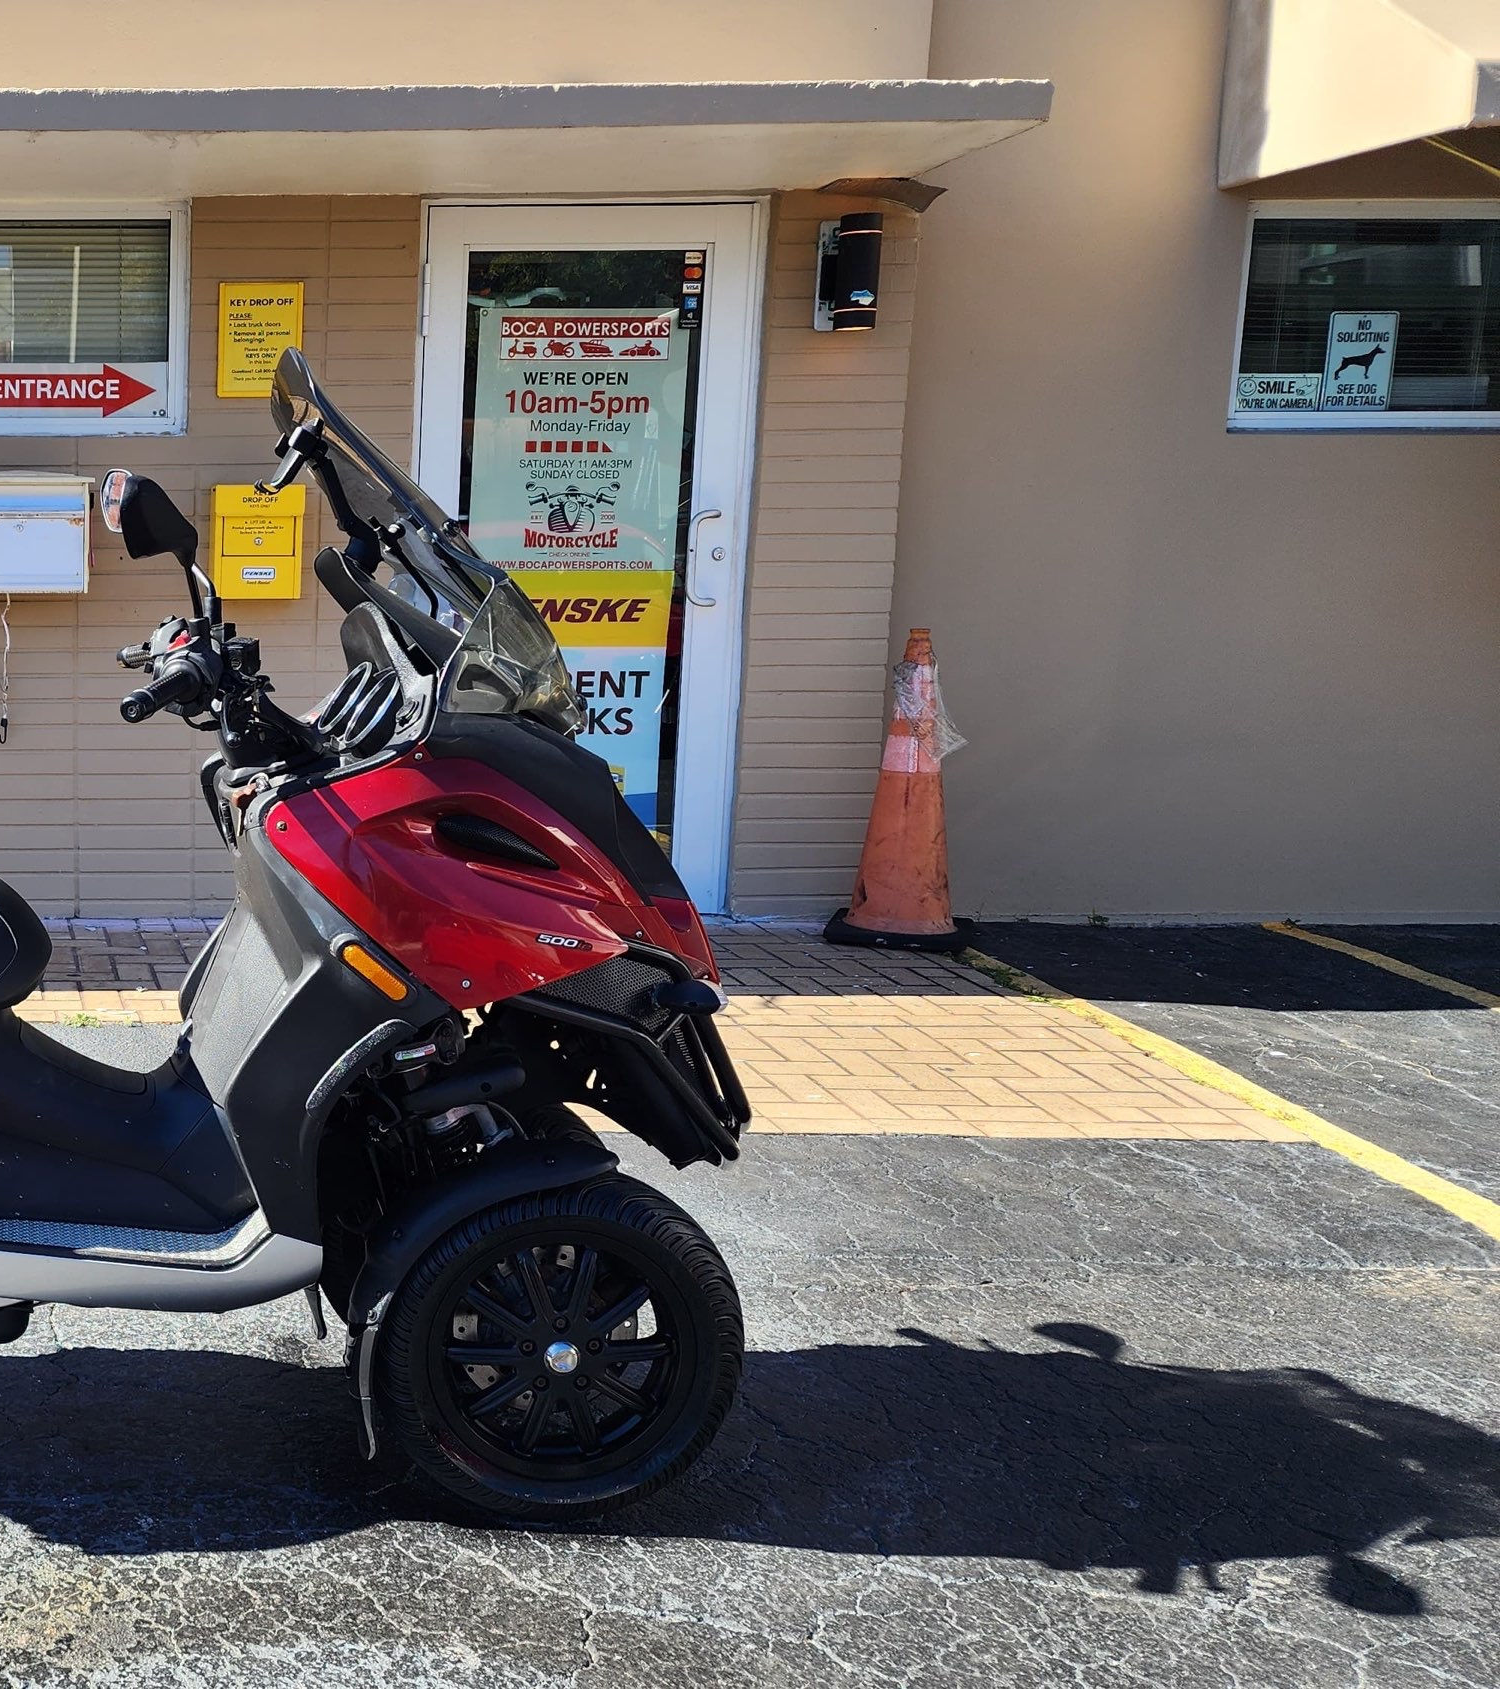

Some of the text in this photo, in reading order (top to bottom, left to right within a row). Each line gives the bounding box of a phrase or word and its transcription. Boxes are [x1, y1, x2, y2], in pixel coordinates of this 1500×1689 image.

[229, 298, 294, 307] KEY DROP OFF
[502, 321, 670, 336] BOCA POWERSPORTS
[1358, 319, 1372, 331] NO
[265, 330, 291, 338] personal
[1336, 331, 1390, 343] SOLICITING
[524, 371, 629, 386] WE'RE OPEN
[1257, 380, 1297, 395] SMILE
[1336, 383, 1377, 395] SEE DOG
[505, 389, 650, 419] 10am-5pm
[1237, 398, 1264, 409] YOU'RE
[1266, 398, 1277, 409] ON
[1325, 395, 1386, 407] FOR DETAILS
[530, 419, 631, 435] Monday-Friday
[519, 459, 633, 469] SATURDAY 11 AM-3PM
[530, 470, 620, 479] SUNDAY CLOSED
[242, 496, 263, 504] DROP
[524, 528, 619, 548] MOTORCYCLE
[531, 598, 652, 623] ENSKE
